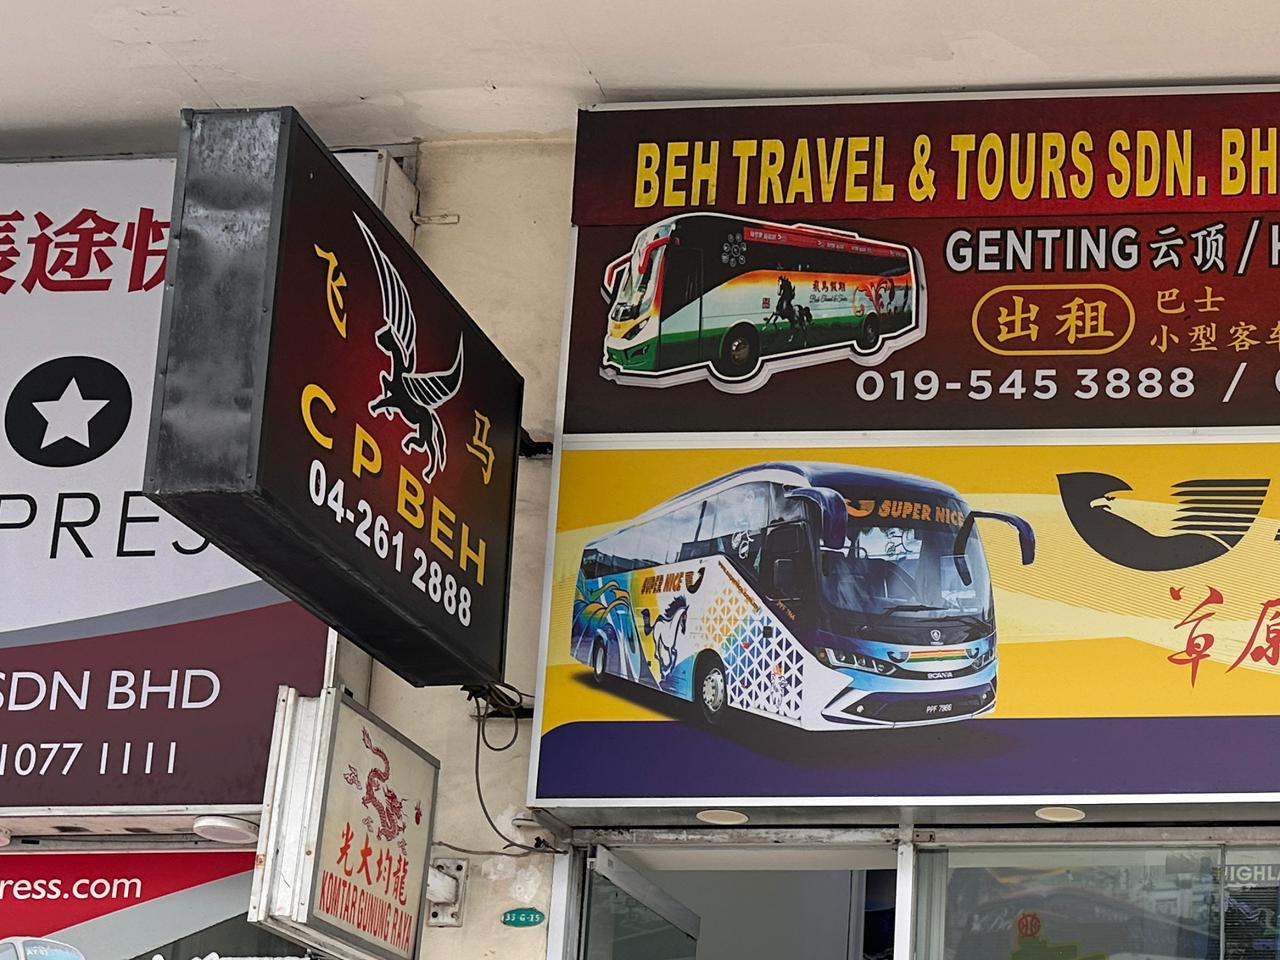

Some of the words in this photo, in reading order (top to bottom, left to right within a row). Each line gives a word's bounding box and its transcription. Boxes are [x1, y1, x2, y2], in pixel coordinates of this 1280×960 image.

[635, 141, 719, 208] BEH
[733, 136, 894, 205] TRAVEL
[909, 133, 936, 202] &
[951, 131, 1094, 200] TOURS
[1108, 129, 1206, 198] SDN.
[946, 228, 1138, 272] GENTING
[1149, 223, 1226, 272] 云顶
[997, 296, 1116, 345] 出租
[1157, 289, 1226, 314] 巴士
[855, 370, 1058, 401] 019-545
[1075, 368, 1195, 399] 3888
[466, 410, 495, 485] 马
[301, 384, 337, 449] C
[352, 424, 382, 476] P
[397, 464, 487, 587] BEH
[878, 500, 931, 521] SUPER
[308, 458, 404, 573] 04-261
[412, 550, 472, 627] 2888
[0, 670, 90, 711] DN
[107, 669, 221, 710] BHD
[319, 870, 358, 925] KOMTAR
[357, 888, 391, 941] GUNUNG
[390, 907, 412, 953] RAYA
